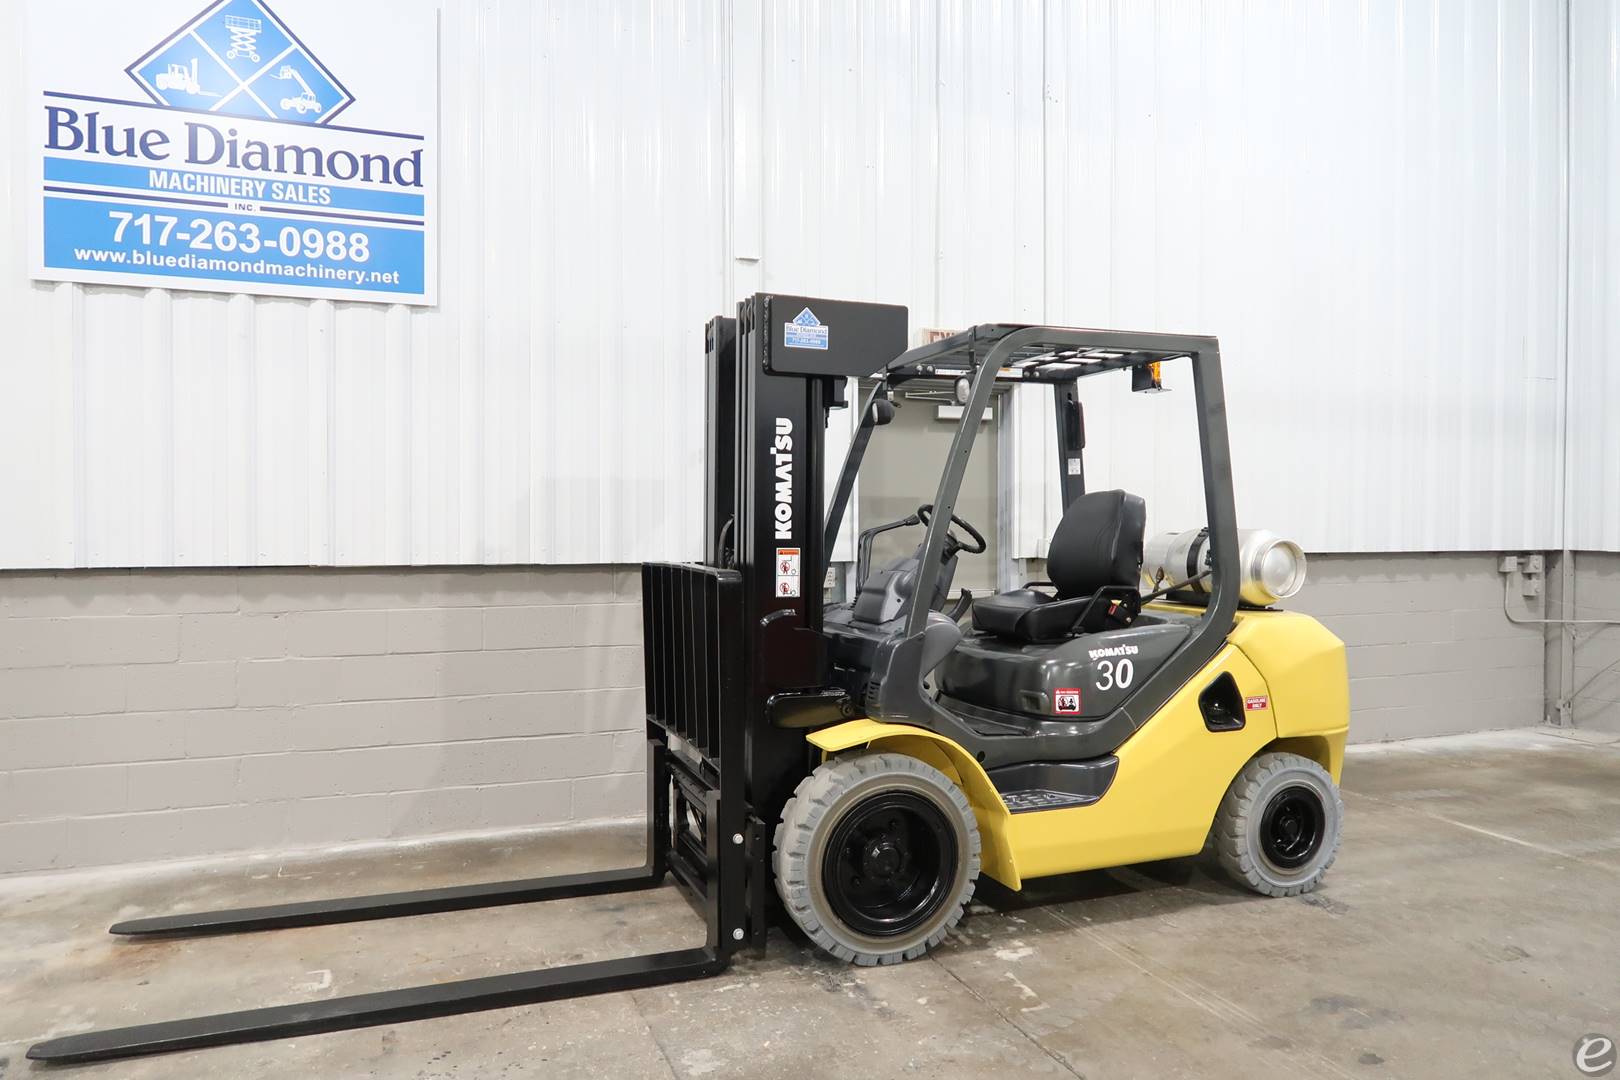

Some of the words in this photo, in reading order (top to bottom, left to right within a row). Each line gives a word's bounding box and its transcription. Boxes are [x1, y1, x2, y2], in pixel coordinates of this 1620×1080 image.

[44, 105, 170, 161] Blue
[184, 121, 423, 187] Diamond
[149, 169, 267, 199] MACHINERY
[271, 182, 331, 205] SALES
[234, 202, 256, 212] INC.
[108, 211, 370, 263] 717-263-0988
[74, 247, 400, 285] www.bluediamondmachinery.net
[770, 417, 793, 540] KOMATSU
[1088, 644, 1139, 661] KOMATSU
[1095, 658, 1134, 691] 30
